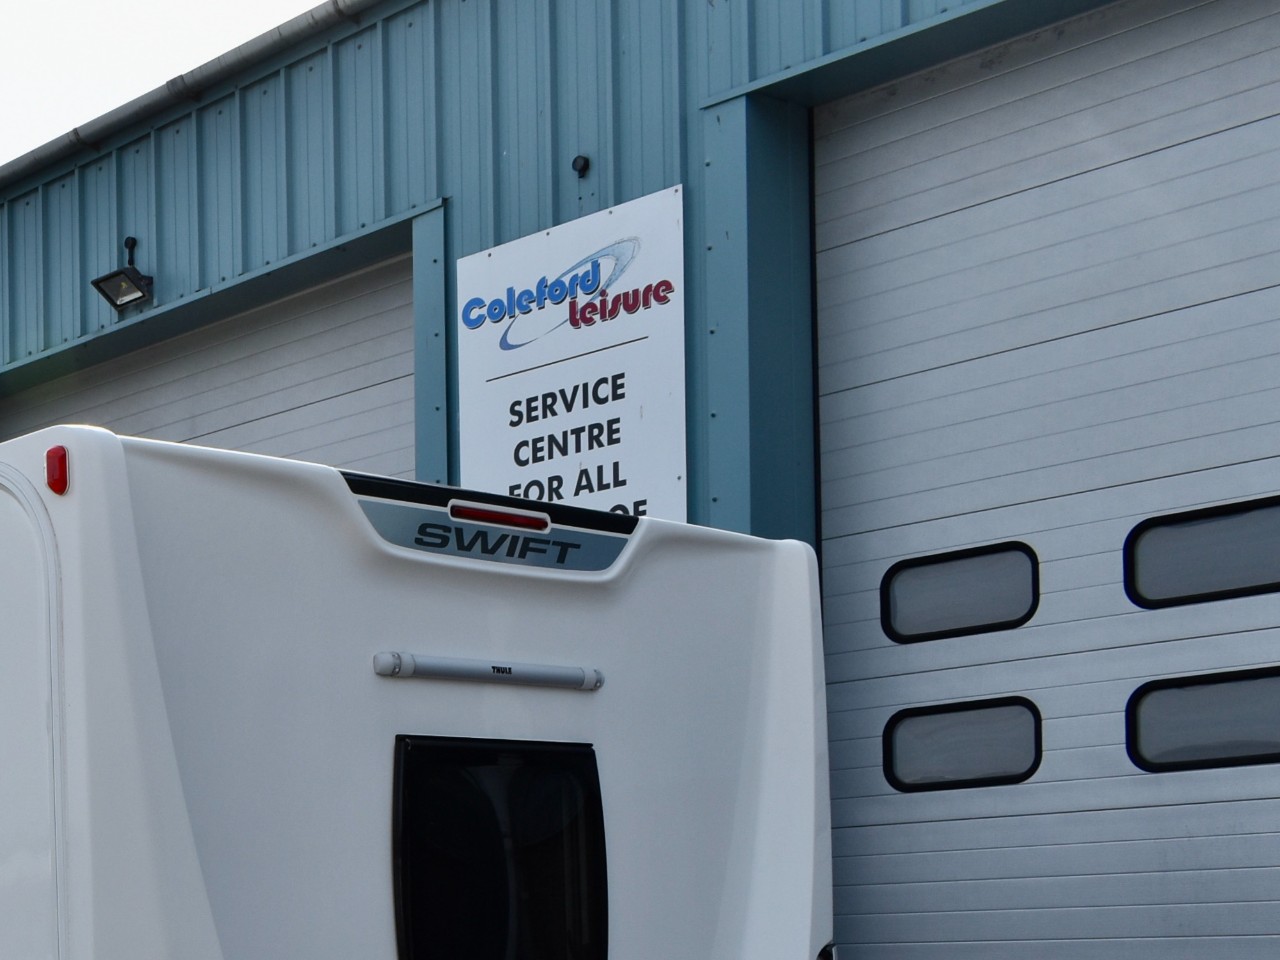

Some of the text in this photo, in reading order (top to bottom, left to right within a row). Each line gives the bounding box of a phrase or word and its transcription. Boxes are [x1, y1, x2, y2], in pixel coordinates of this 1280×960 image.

[461, 259, 601, 329] Coleford
[509, 372, 626, 428] SERVICE
[513, 417, 621, 467] CENTRE
[573, 461, 627, 497] ALL
[414, 522, 582, 564] SWIFT
[491, 665, 512, 675] THULE
